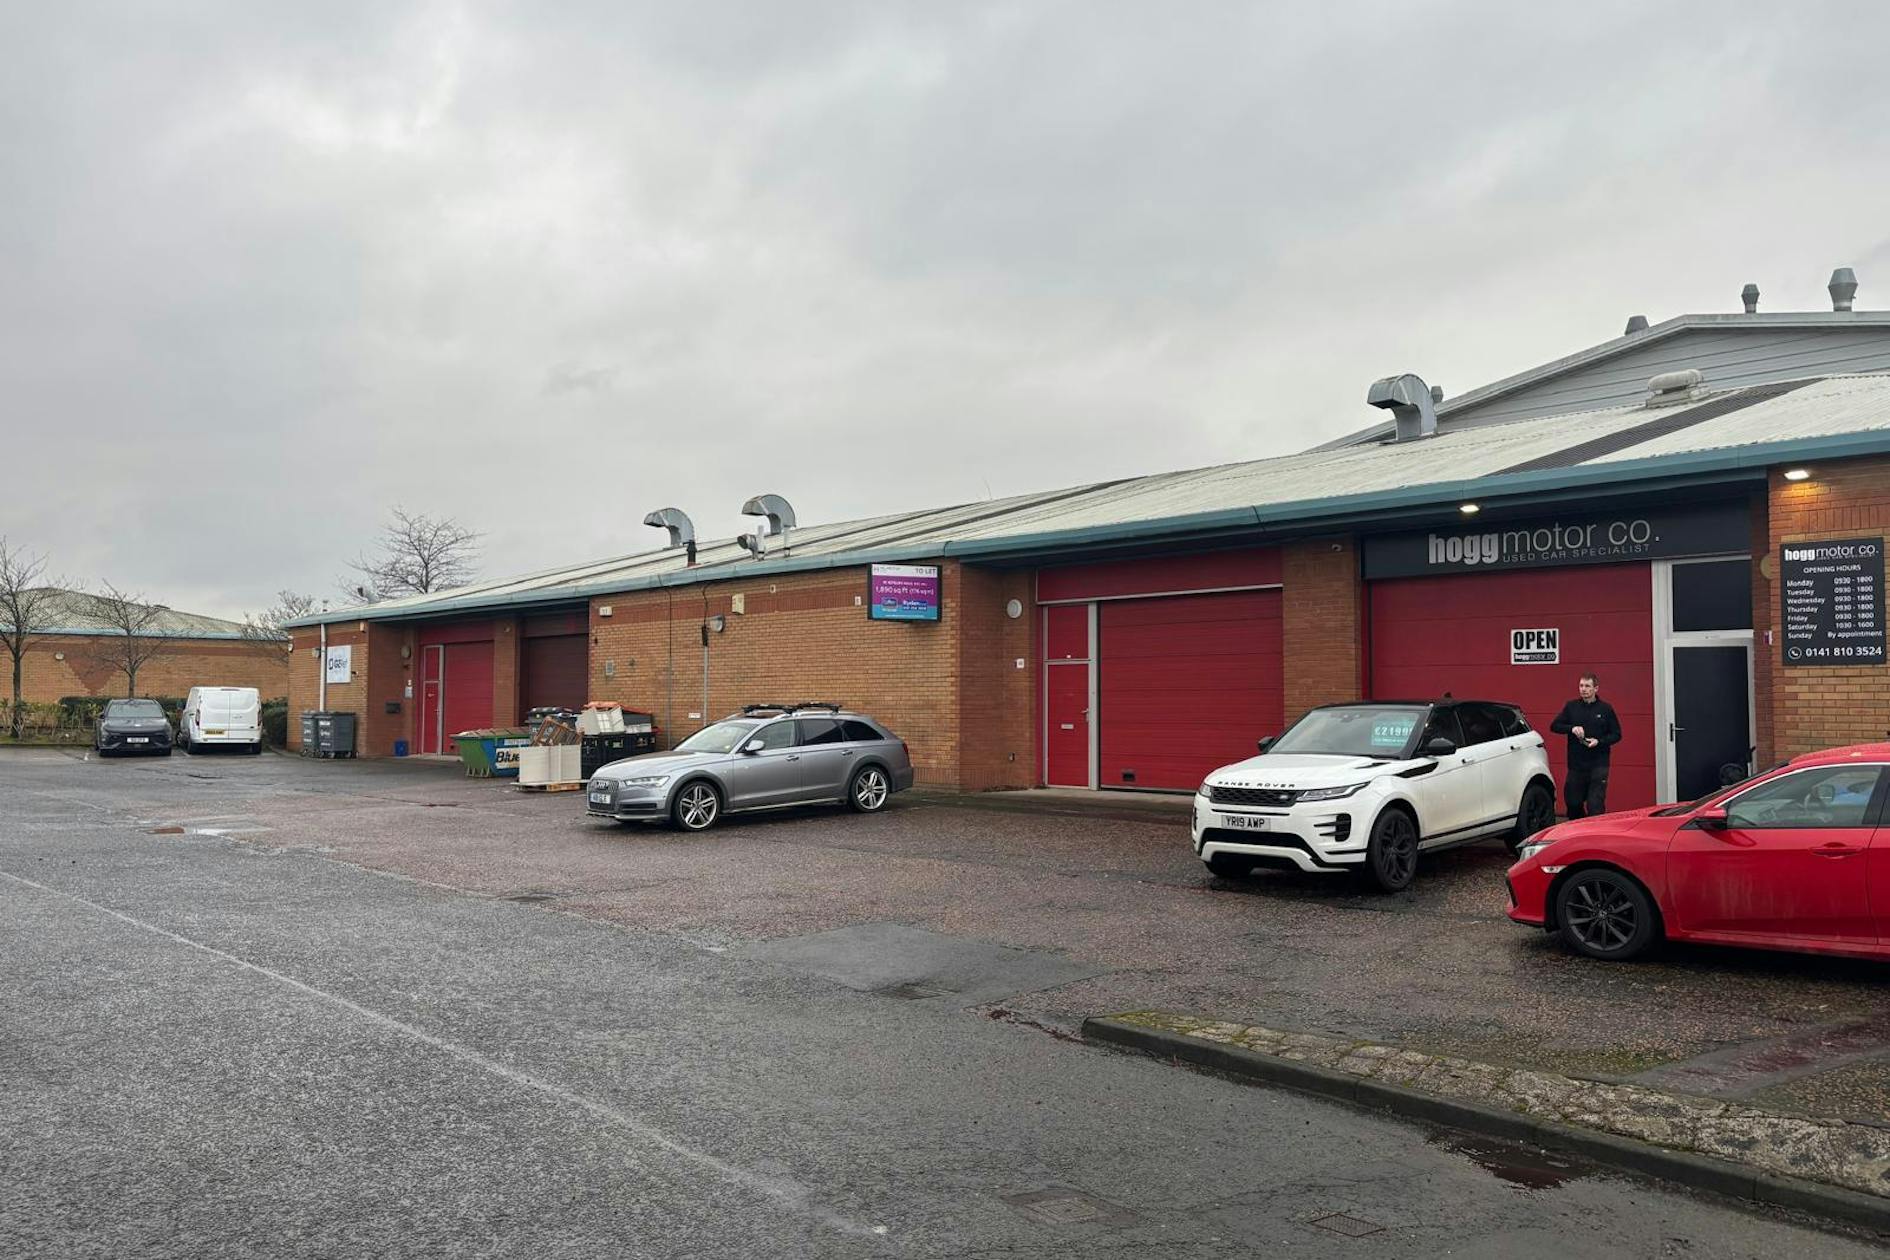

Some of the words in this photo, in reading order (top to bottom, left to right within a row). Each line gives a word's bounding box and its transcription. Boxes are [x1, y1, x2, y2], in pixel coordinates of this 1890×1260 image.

[1428, 532, 1499, 565] hogg
[1502, 521, 1597, 554] motor
[1503, 553, 1536, 563] USED
[1541, 551, 1567, 561] CAR
[1573, 543, 1651, 558] SPECIALIST
[1784, 549, 1815, 562] hogg
[1816, 545, 1855, 557] motor
[1803, 566, 1835, 574] OPENING
[1836, 564, 1861, 572] HOURS
[1787, 579, 1814, 587] Monday
[1787, 596, 1826, 605] Wednesday
[1787, 623, 1818, 631] Saturday
[1513, 630, 1557, 650] OPEN
[1788, 632, 1812, 640] Sunday
[1837, 630, 1883, 639] appointment
[1805, 647, 1830, 657] 0141
[1833, 647, 1853, 657] 810
[1856, 646, 1883, 656] 3524
[1225, 816, 1245, 828] YR19
[1247, 817, 1265, 829] AWP
